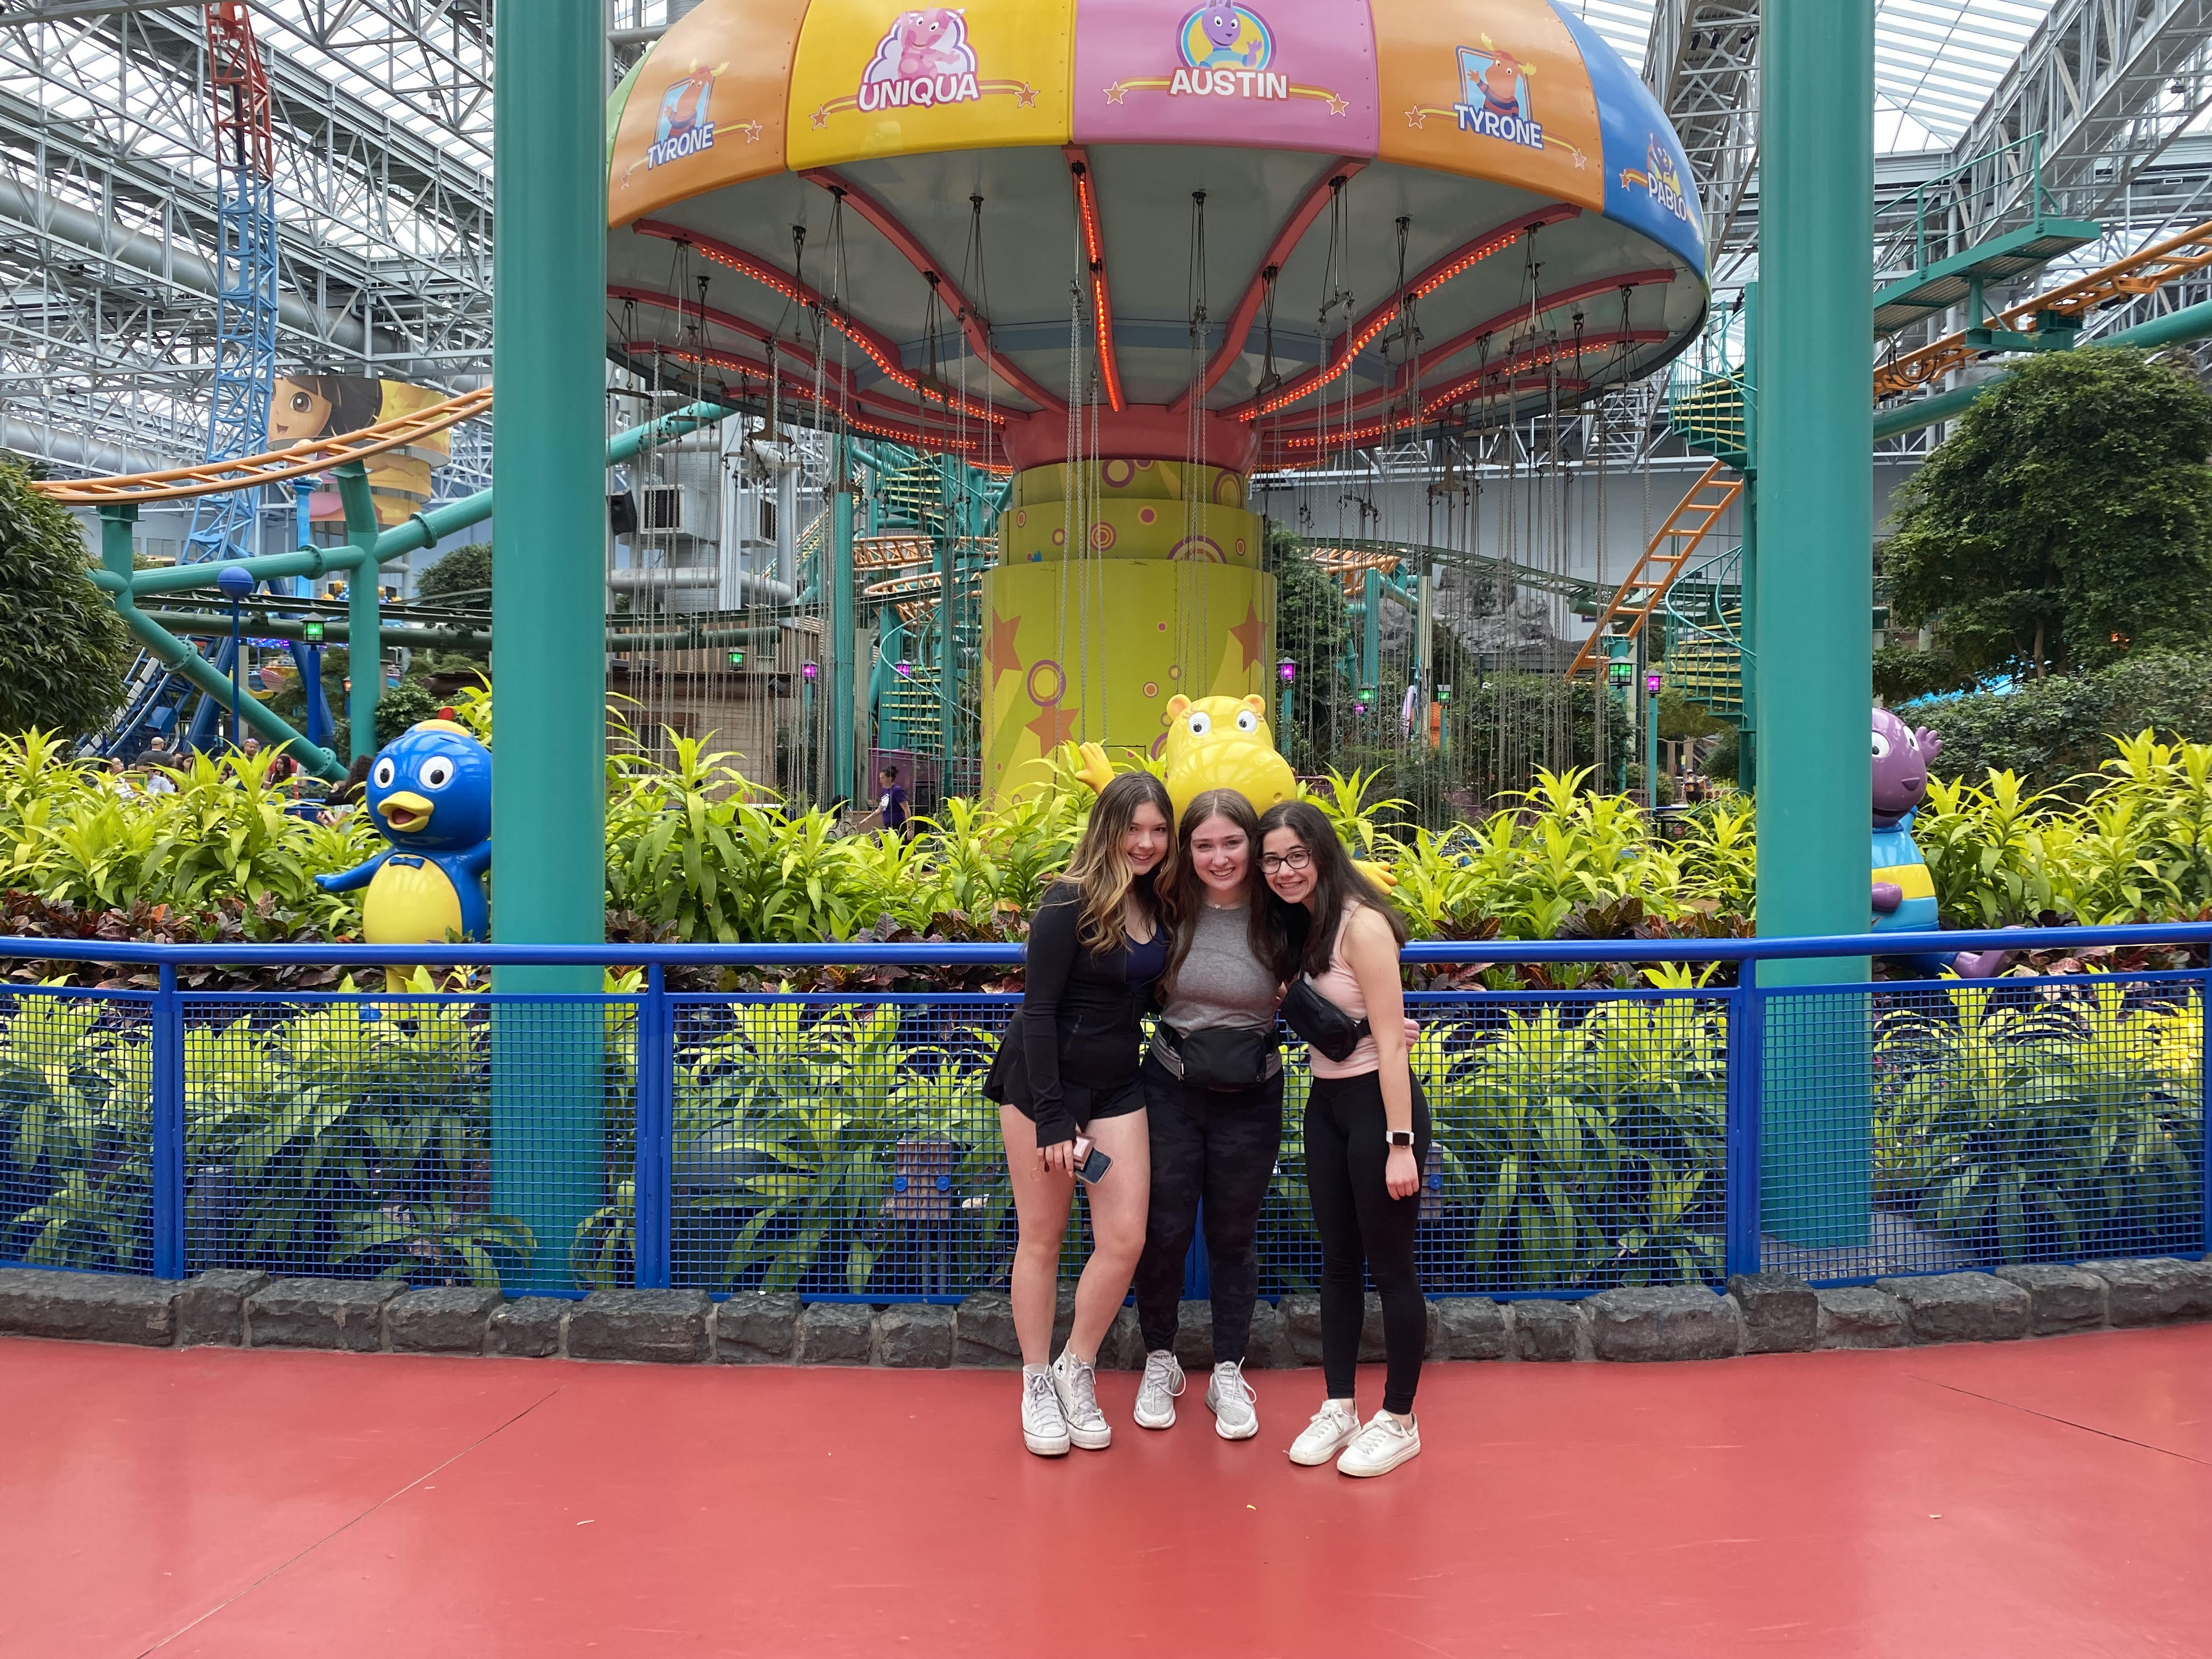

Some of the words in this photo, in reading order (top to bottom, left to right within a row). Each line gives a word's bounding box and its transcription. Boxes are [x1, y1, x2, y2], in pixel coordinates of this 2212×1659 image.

[859, 74, 979, 110] UNIQUA
[1170, 69, 1287, 98] AUSTIN
[647, 122, 714, 171] TYRONE
[1454, 104, 1543, 149] TYRONE
[1647, 171, 1686, 222] PABLO
